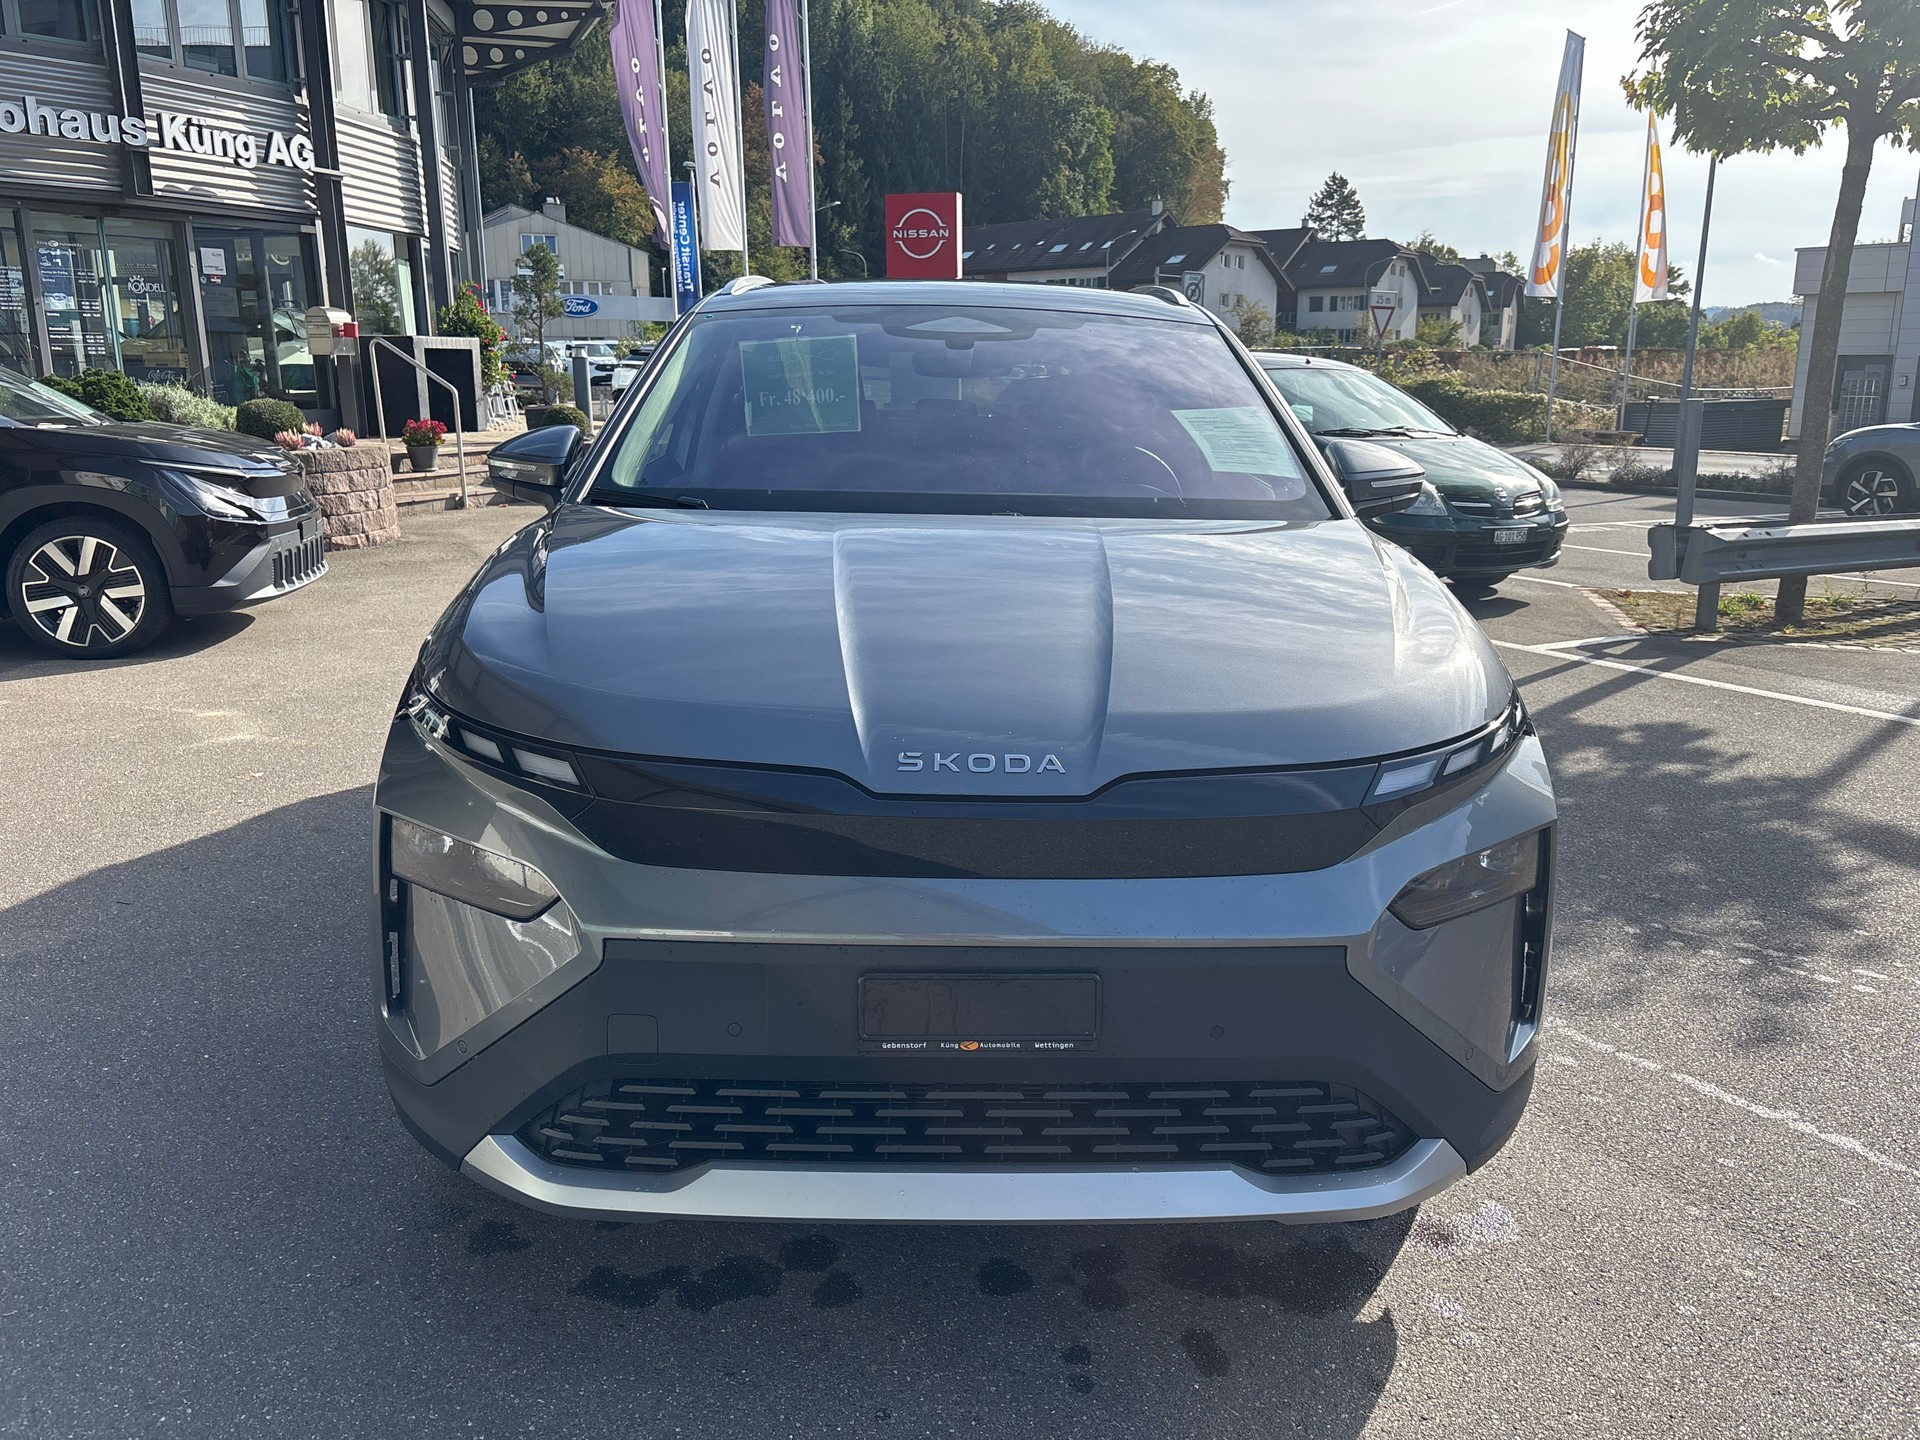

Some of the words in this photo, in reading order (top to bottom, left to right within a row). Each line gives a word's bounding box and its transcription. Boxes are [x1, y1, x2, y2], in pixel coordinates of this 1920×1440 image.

[159, 112, 257, 169] Küng
[266, 131, 315, 170] AG
[892, 229, 949, 238] NISSAN
[564, 298, 591, 313] Ford
[1376, 295, 1384, 304] 25
[758, 391, 781, 407] Fr.
[882, 1041, 928, 1050] Gebenstorf
[940, 1041, 959, 1050] Küng
[979, 1041, 1021, 1049] Automobile
[1034, 1041, 1075, 1050] Wettingen
